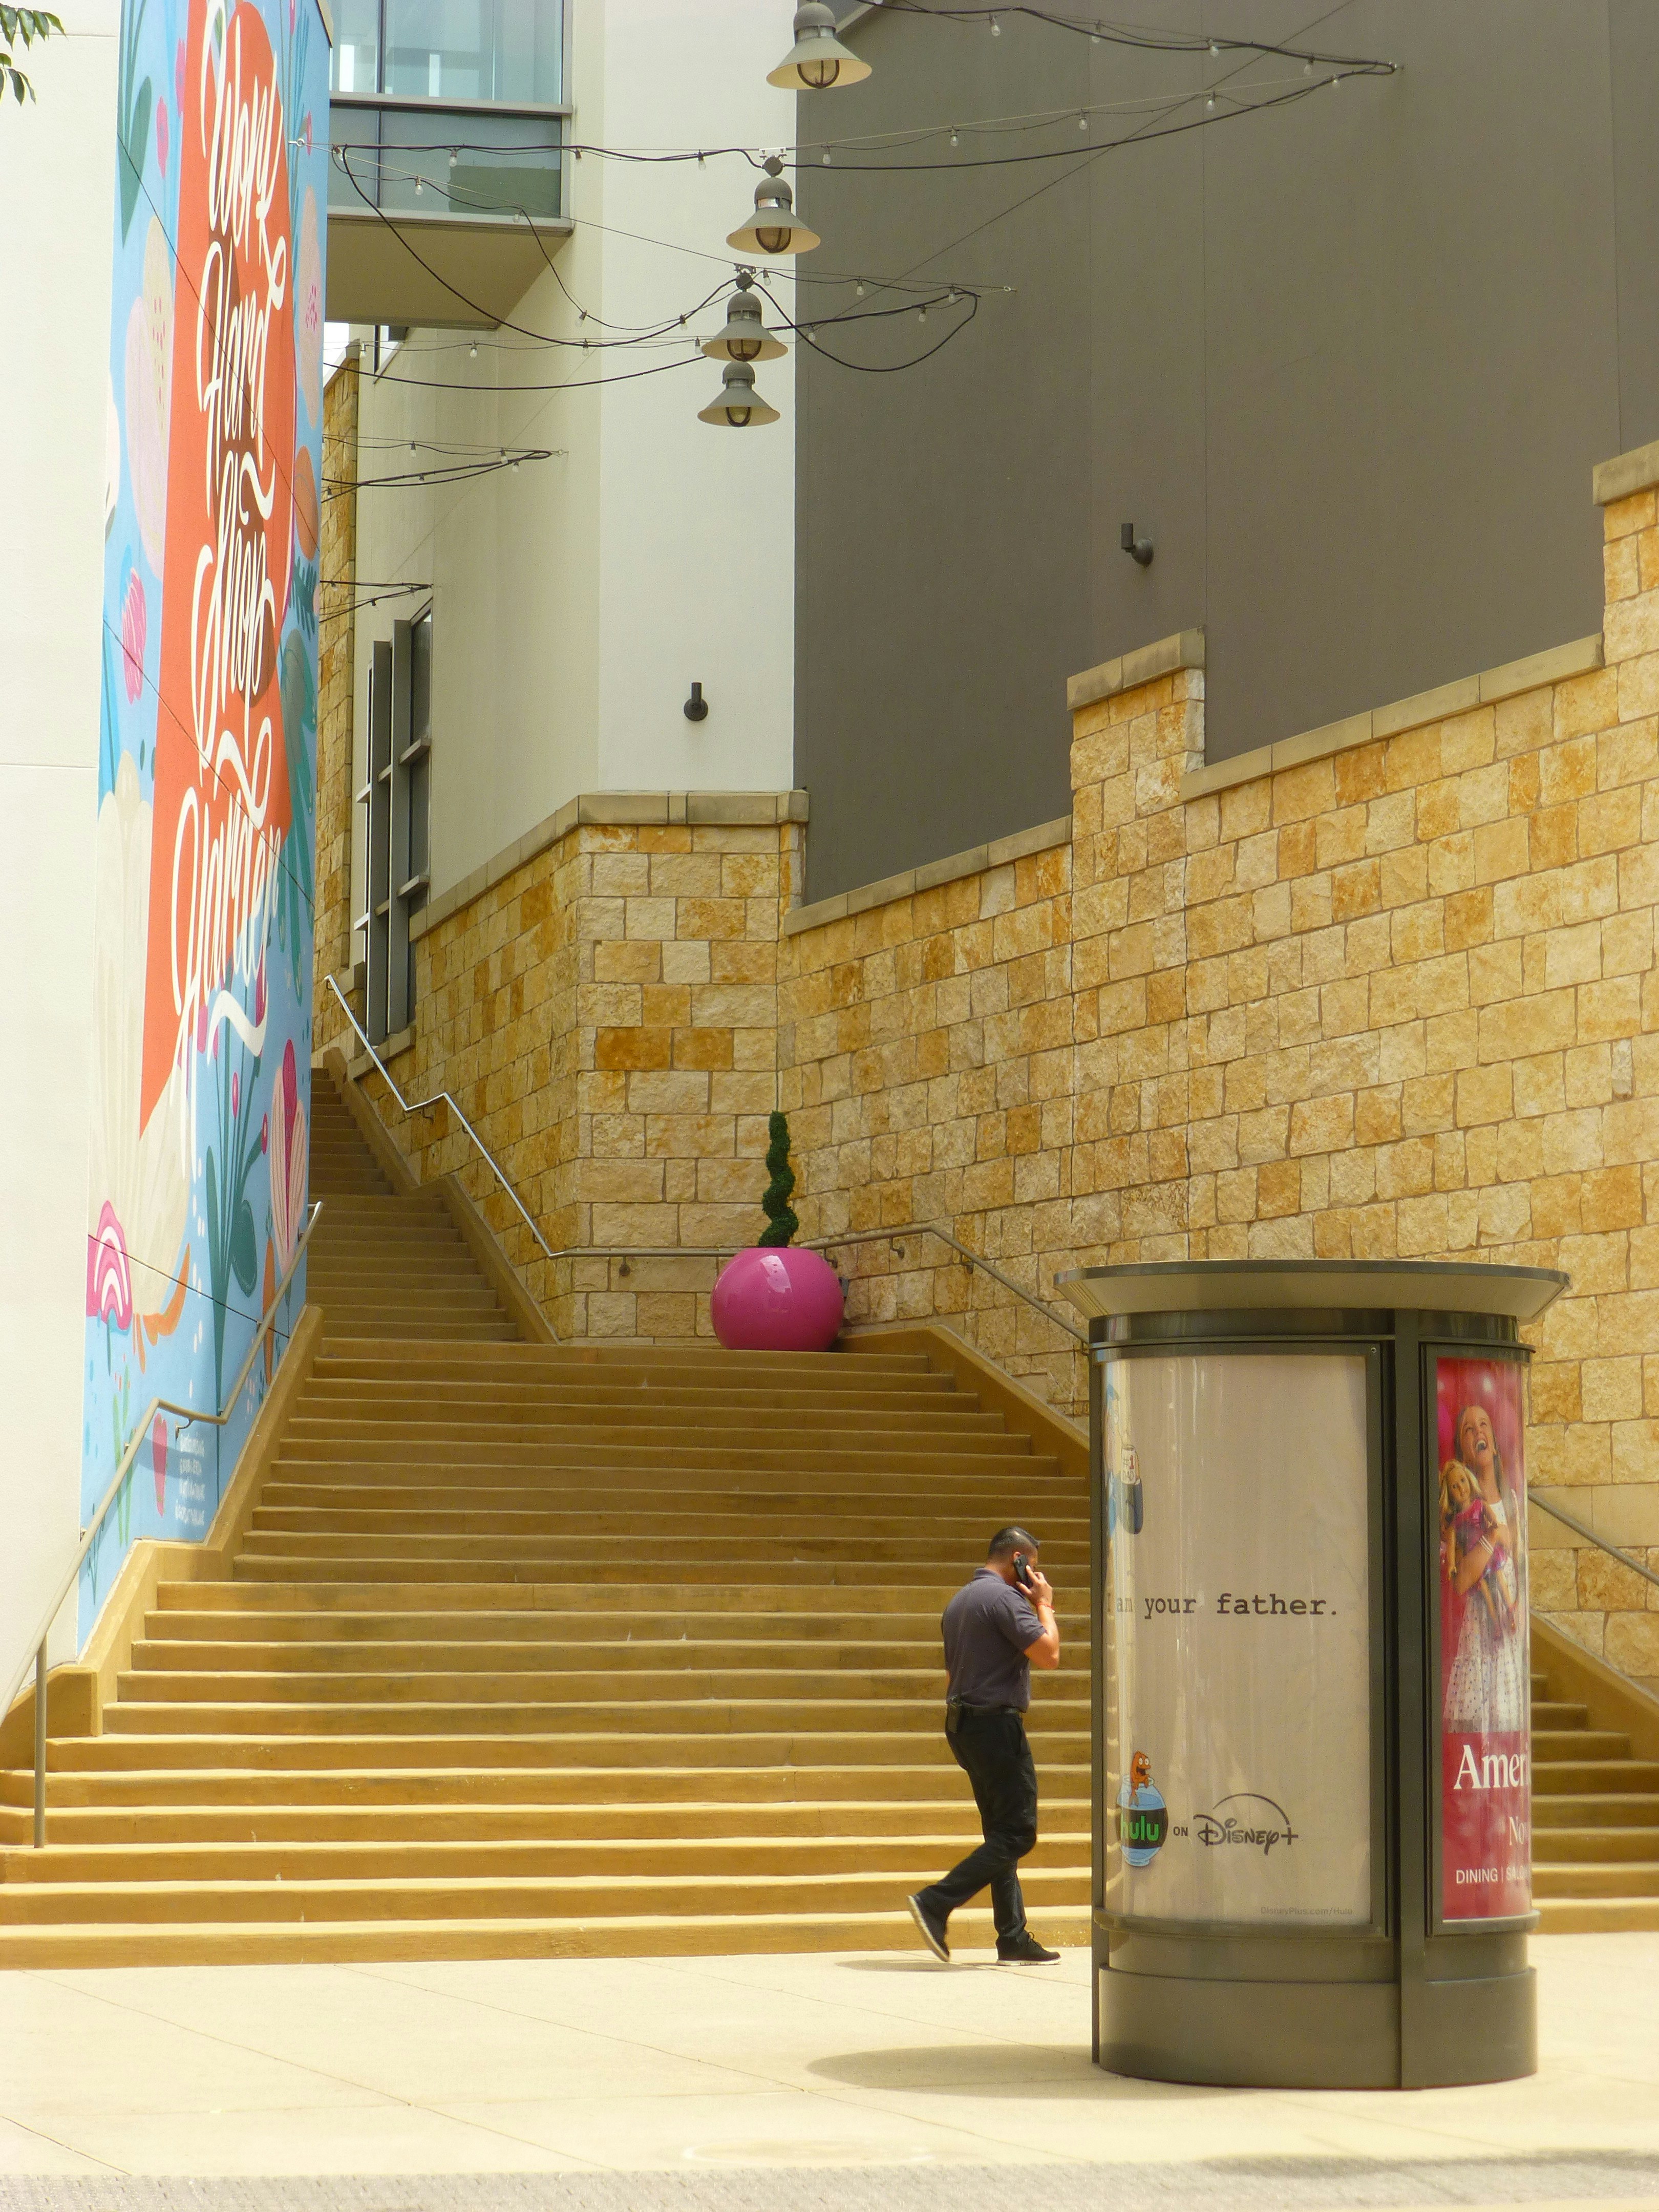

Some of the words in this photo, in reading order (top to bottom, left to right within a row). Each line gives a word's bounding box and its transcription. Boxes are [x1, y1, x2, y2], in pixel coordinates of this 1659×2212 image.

[190, 450, 276, 786] Shop
[1144, 1596, 1197, 1620] your
[1217, 1592, 1337, 1615] father.
[1453, 1744, 1527, 1790] Amer
[1173, 1825, 1188, 1837] ON
[1456, 1867, 1498, 1884] DINING
